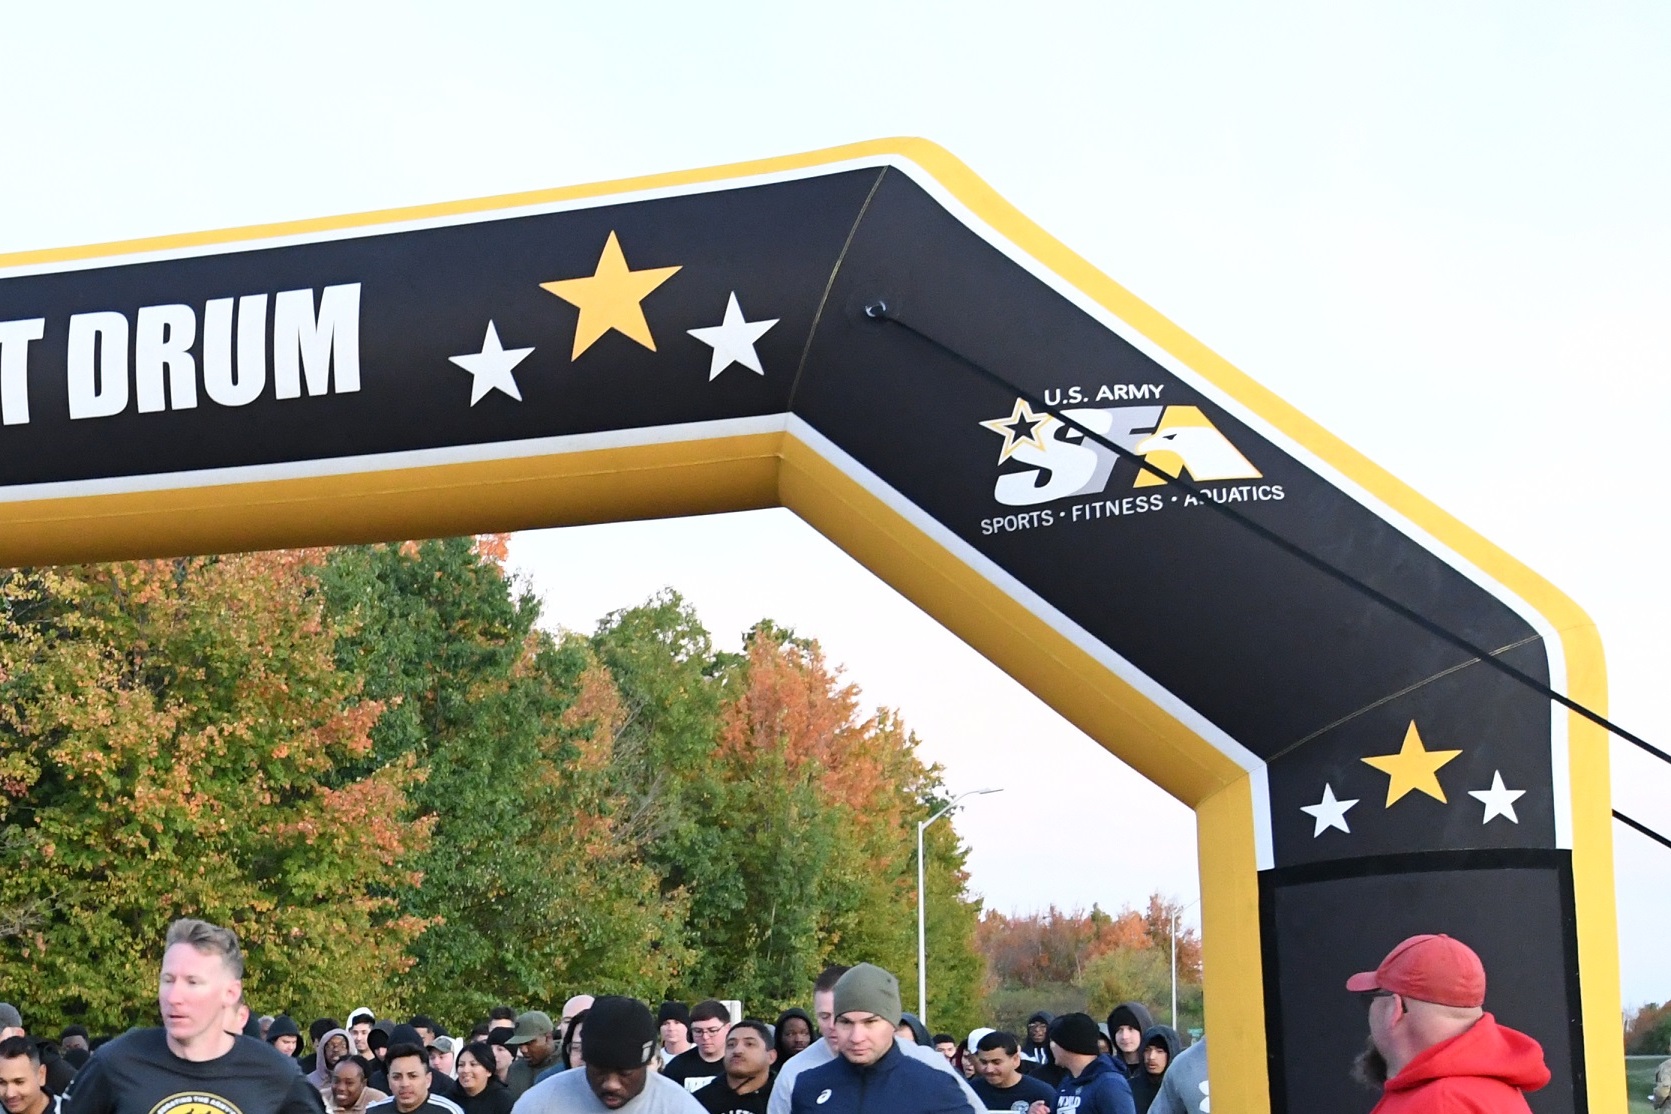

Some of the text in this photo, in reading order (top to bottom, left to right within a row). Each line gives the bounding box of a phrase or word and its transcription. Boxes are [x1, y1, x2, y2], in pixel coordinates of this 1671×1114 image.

[67, 283, 362, 421] DRUM
[1044, 384, 1165, 406] U.S. ARMY
[980, 510, 1054, 536] SPORTS
[1072, 494, 1163, 523] FITNESS
